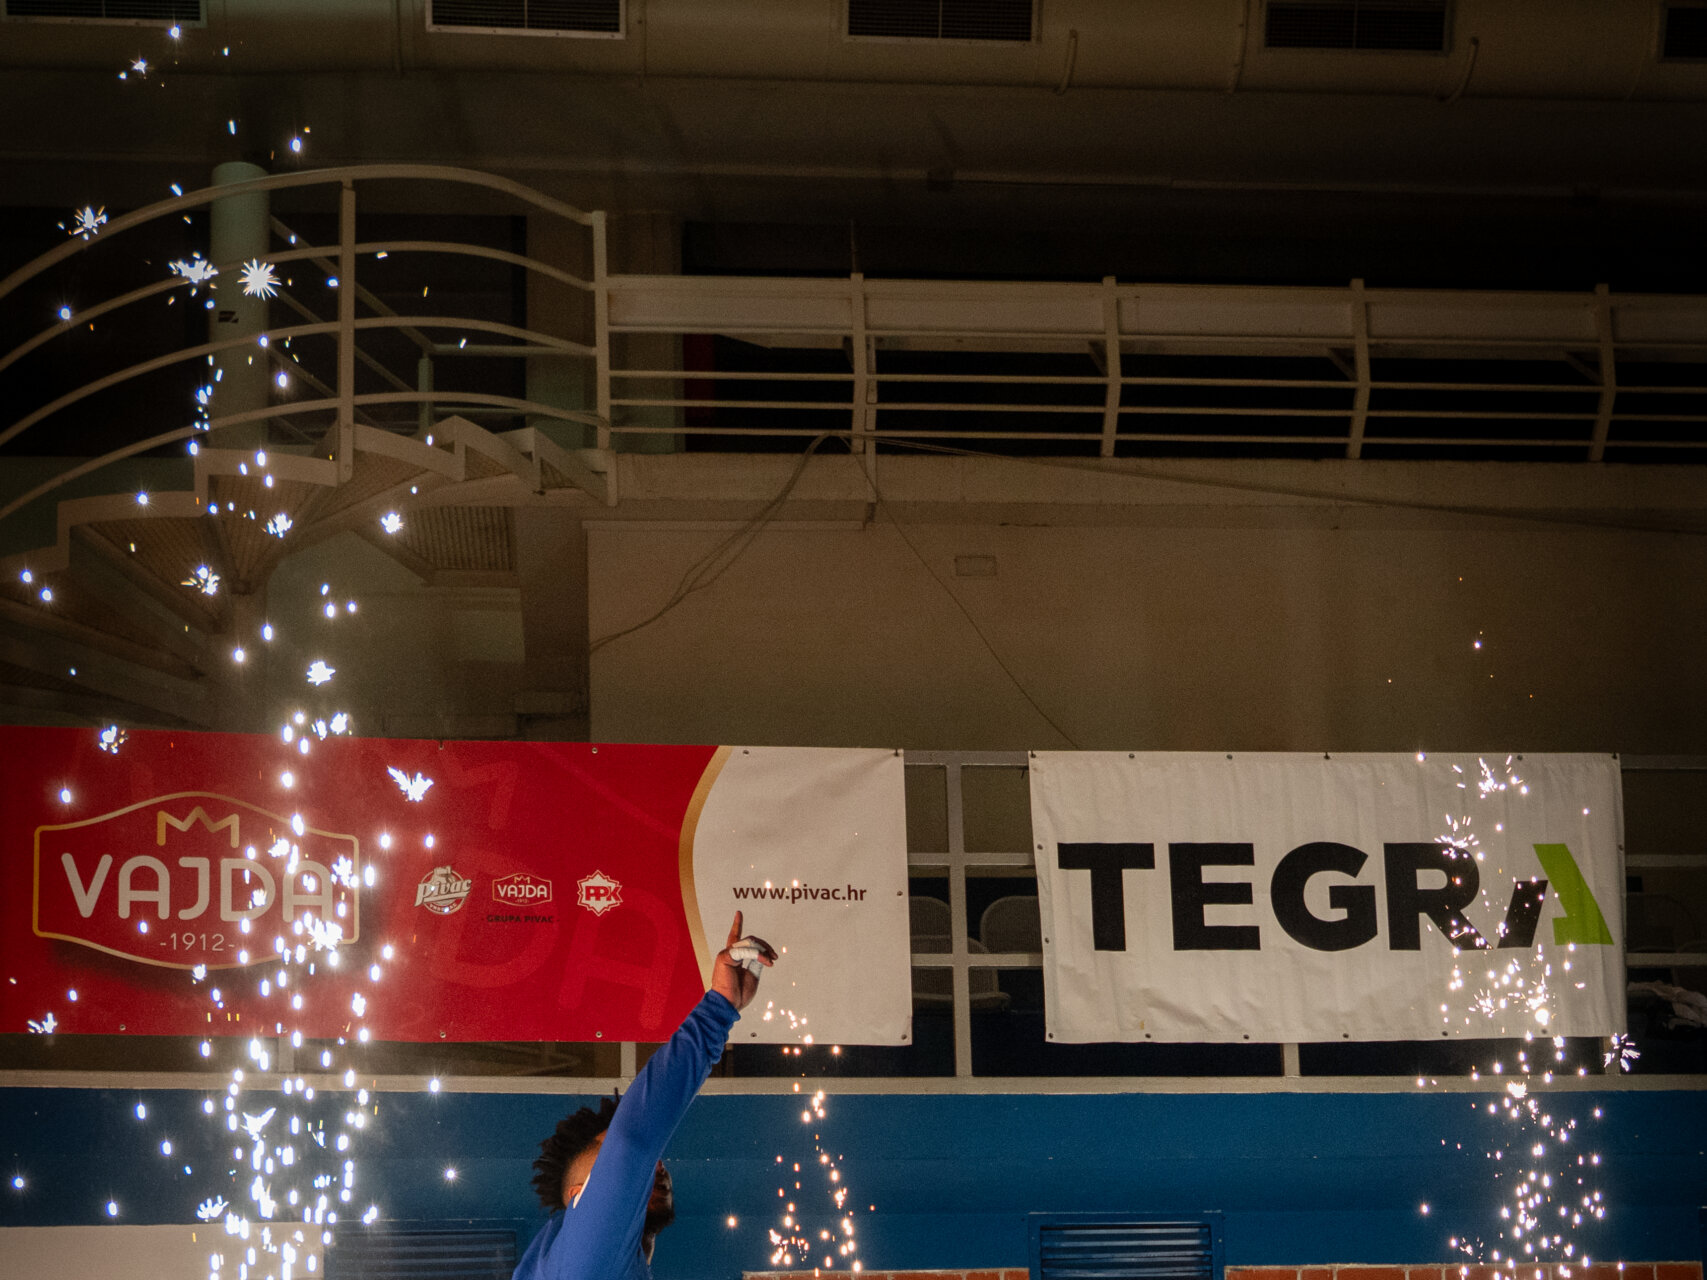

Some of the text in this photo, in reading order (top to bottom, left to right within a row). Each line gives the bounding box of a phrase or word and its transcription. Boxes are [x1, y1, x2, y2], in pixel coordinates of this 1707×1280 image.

[61, 853, 333, 922] VAJDA
[497, 884, 548, 898] VAJDA
[585, 885, 622, 902] PPK
[733, 884, 867, 904] www.pivac.hr
[1057, 842, 1614, 952] TEGRA
[524, 915, 554, 923] PIVAC
